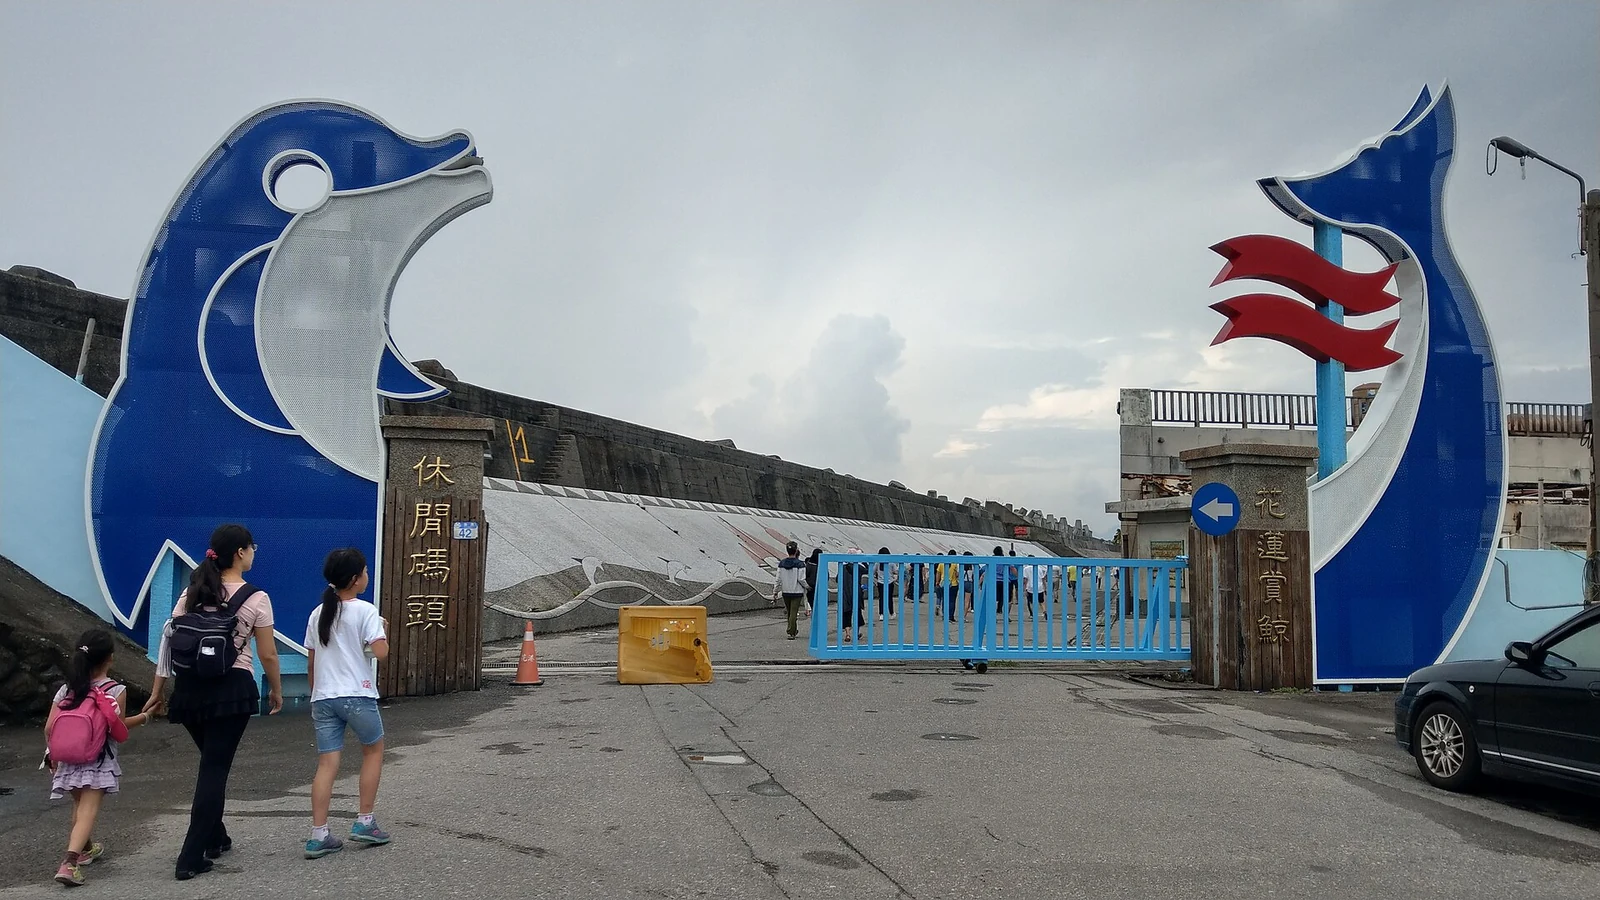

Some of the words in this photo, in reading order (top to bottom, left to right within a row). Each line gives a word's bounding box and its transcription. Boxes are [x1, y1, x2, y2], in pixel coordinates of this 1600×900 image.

[406, 455, 455, 631] 休閒碼頭
[459, 528, 472, 538] 42
[1255, 487, 1290, 643] 花蓮賞鯨
